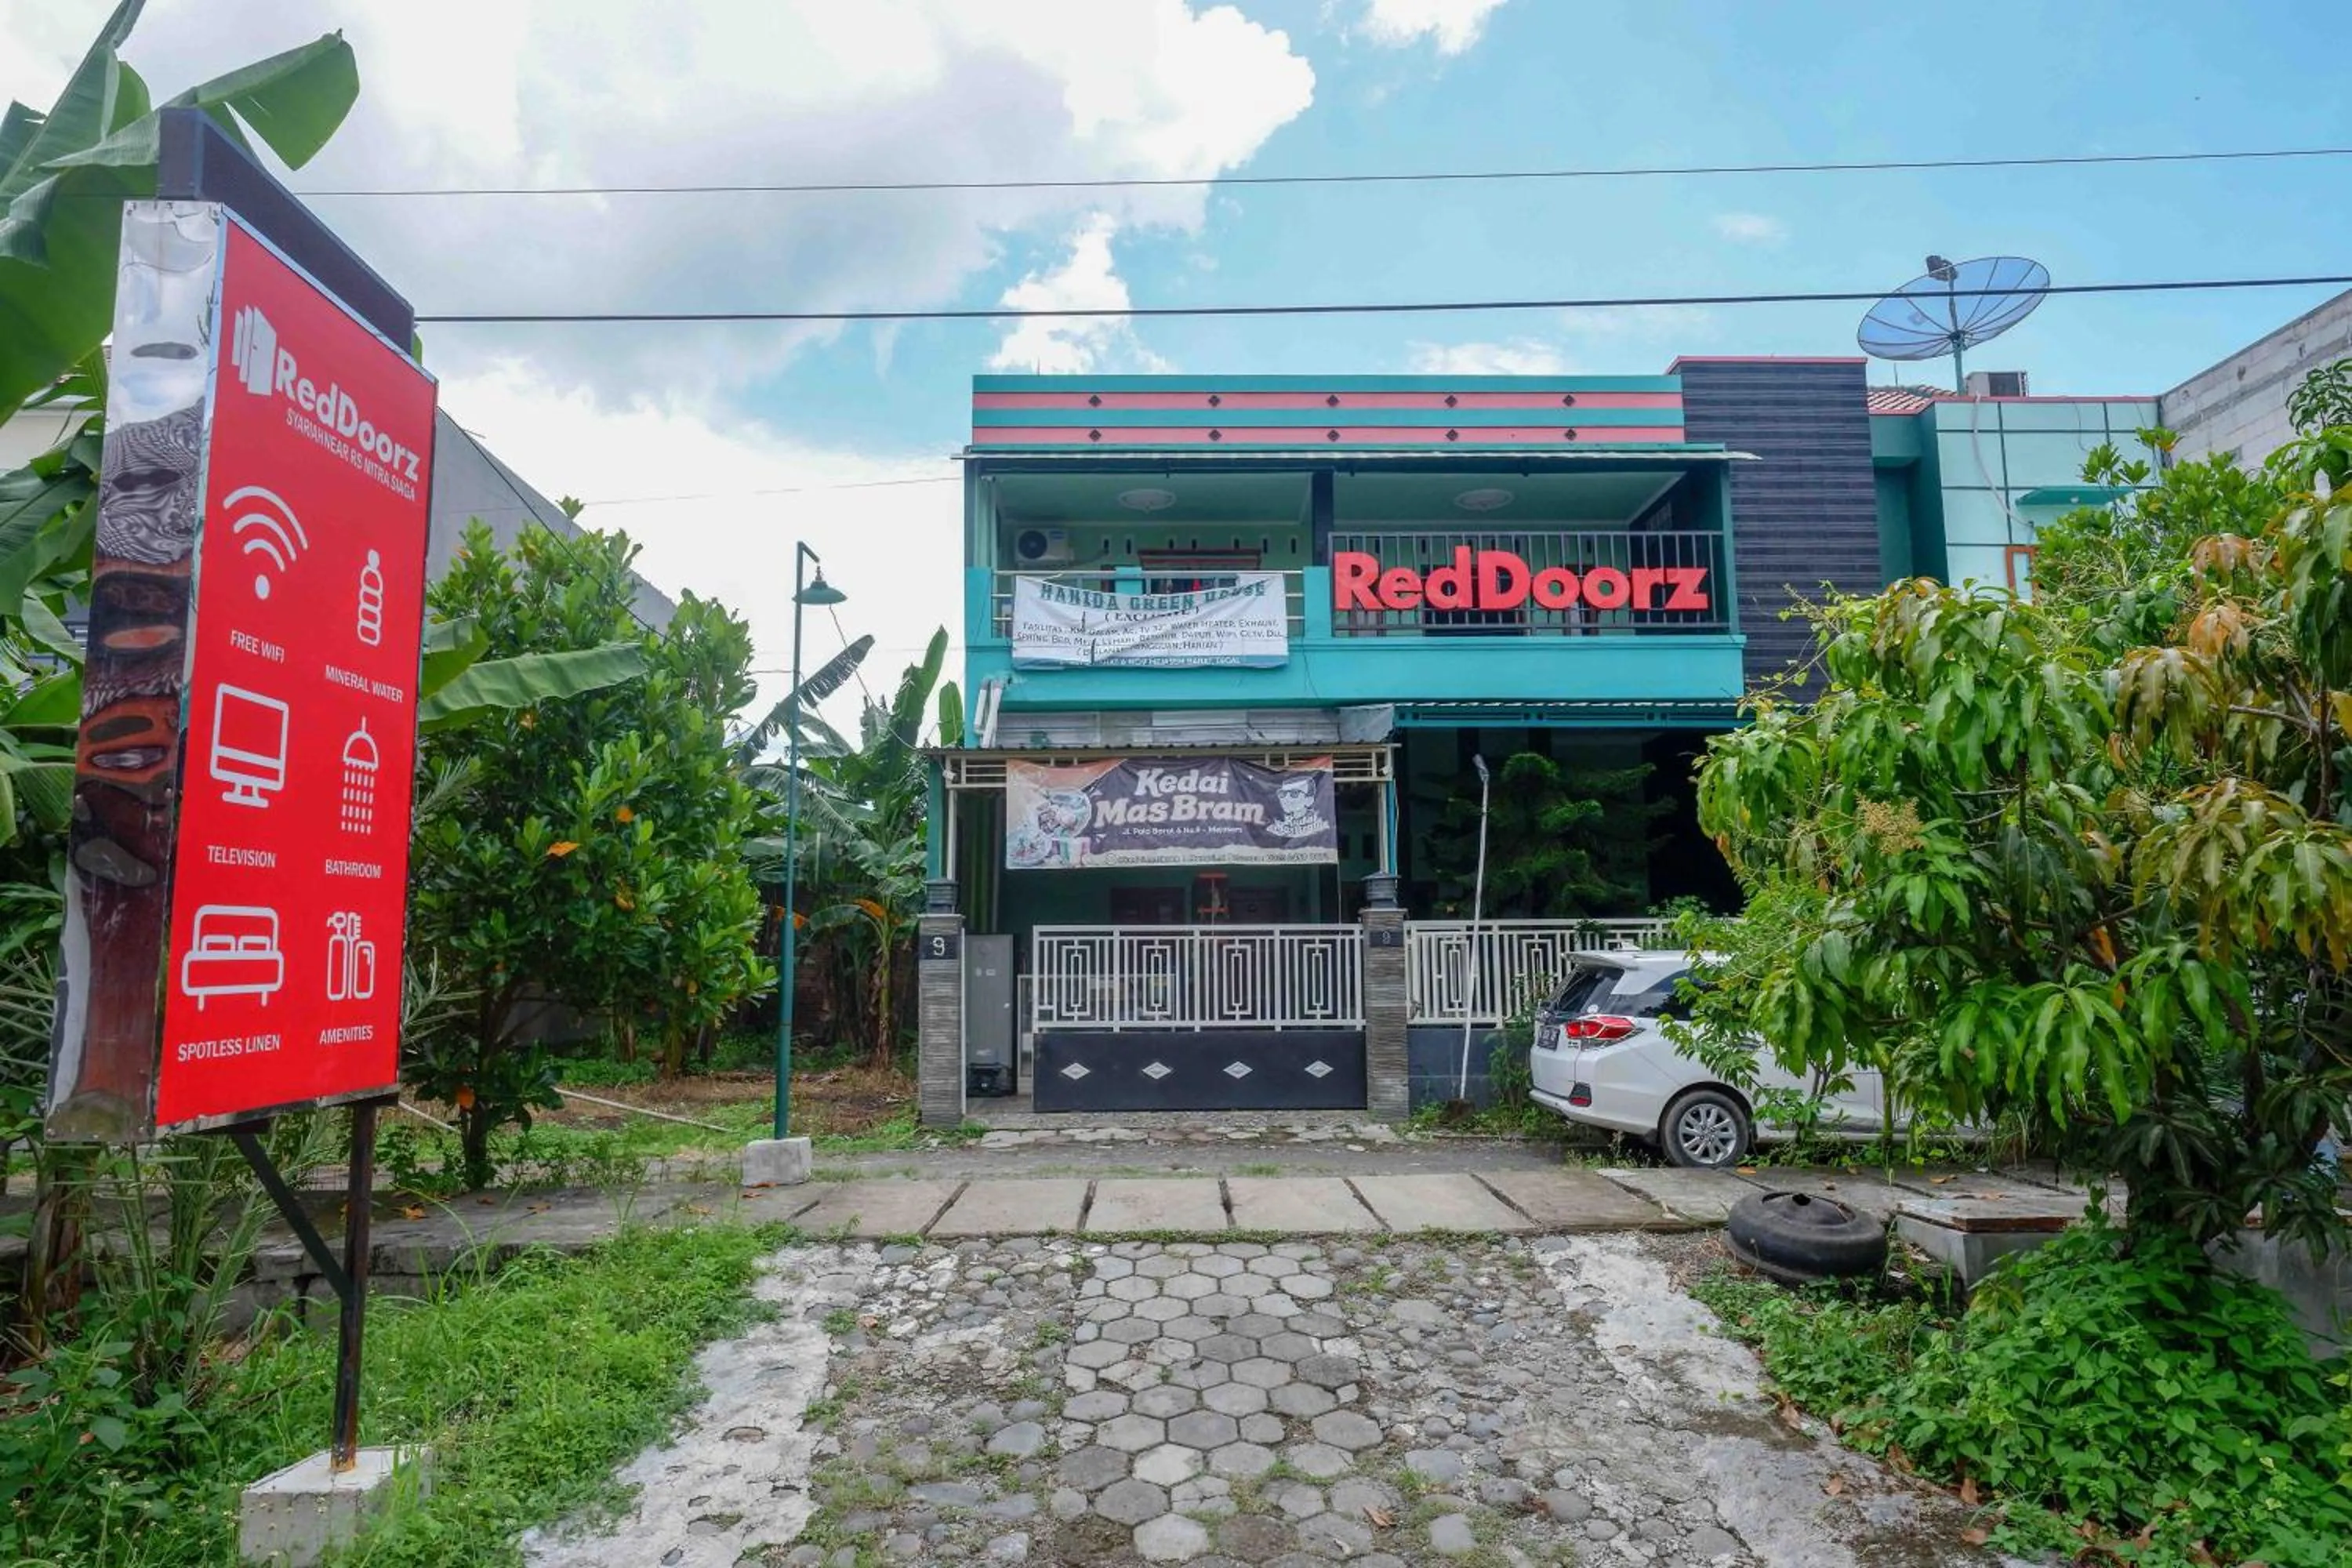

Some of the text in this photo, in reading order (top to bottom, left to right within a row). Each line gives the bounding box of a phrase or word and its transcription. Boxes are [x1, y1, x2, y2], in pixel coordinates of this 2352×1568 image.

[276, 347, 420, 482] RedDoorz
[1334, 546, 1709, 611] RedDoorz
[1130, 594, 1194, 611] GREEN
[230, 630, 285, 664] FREE WIFI
[325, 664, 404, 703] MINERAL WATER
[1134, 768, 1229, 797] Kedai
[207, 844, 276, 868] TELEVISION
[325, 858, 383, 879] BATHROOM
[932, 937, 946, 956] 9
[178, 1034, 281, 1062] SPOTLESS LINEN
[319, 1025, 373, 1045] AMENITIES
